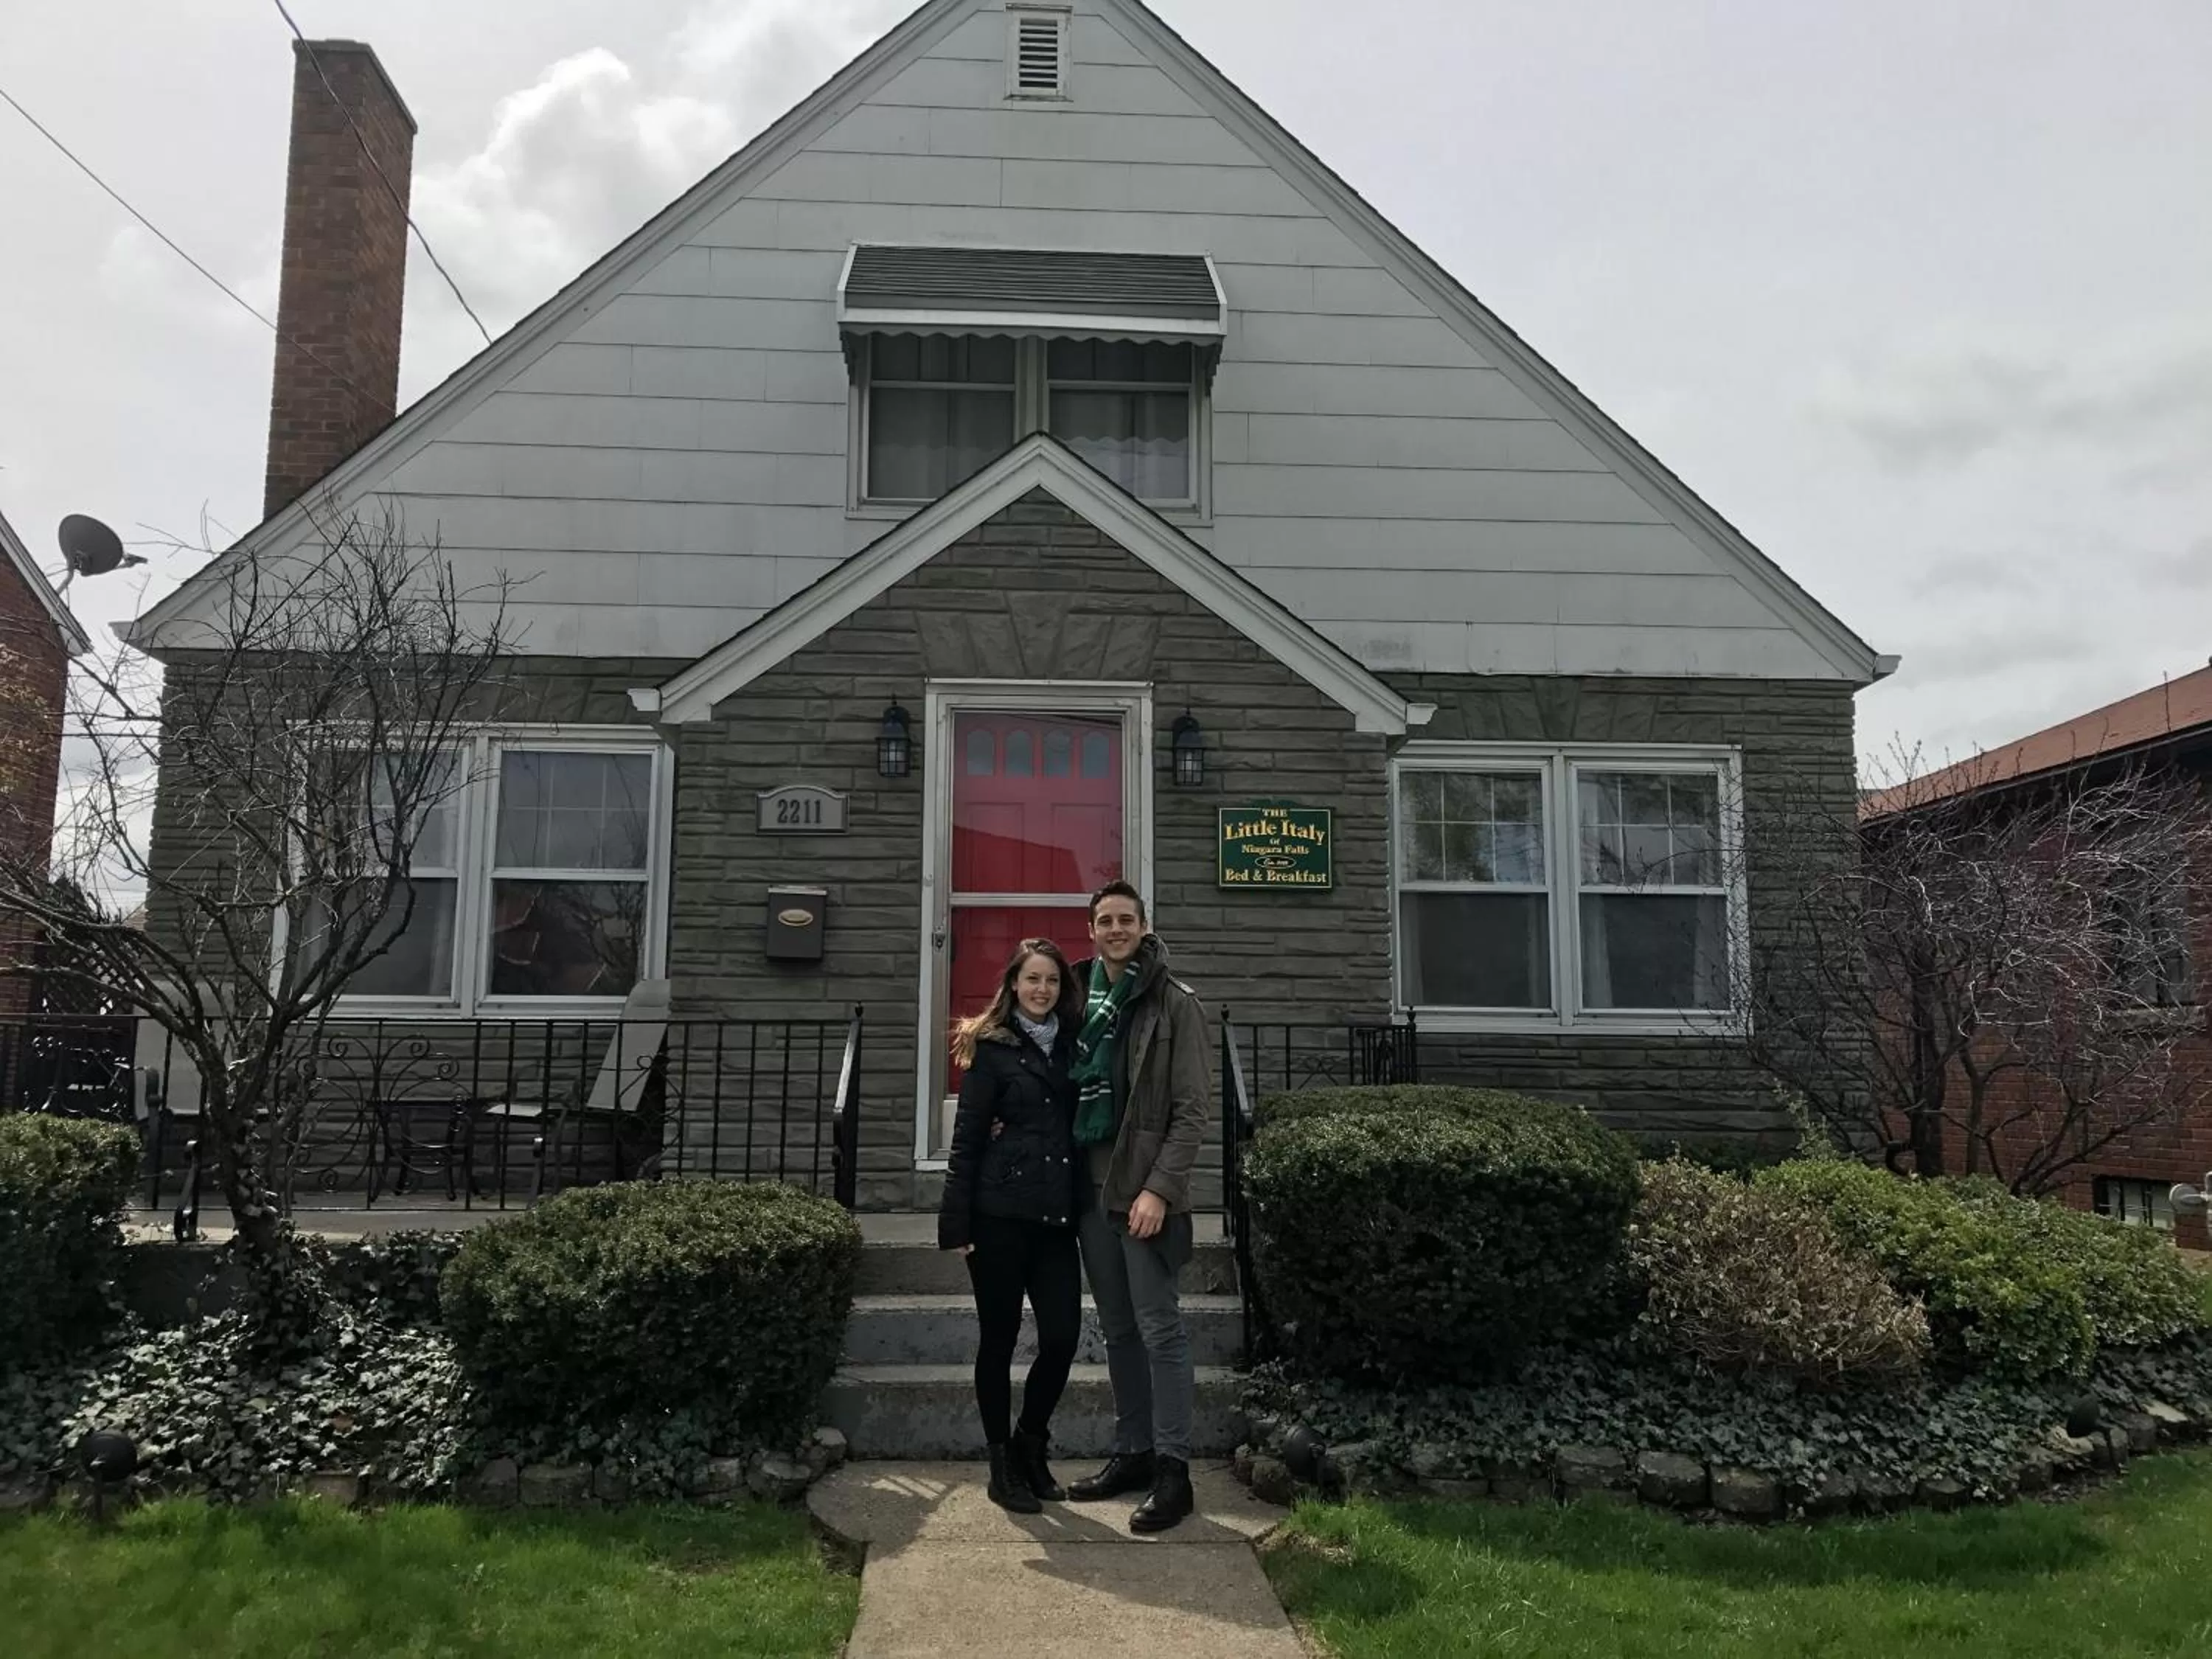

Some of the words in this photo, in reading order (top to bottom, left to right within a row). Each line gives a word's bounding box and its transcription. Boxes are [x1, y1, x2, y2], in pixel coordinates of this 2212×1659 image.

[777, 799, 822, 824] 2211
[1262, 808, 1287, 817] THE
[1225, 820, 1277, 840] Little
[1281, 820, 1325, 845] Italy
[1242, 845, 1282, 855] Niagara
[1284, 845, 1310, 855] Falls
[1225, 869, 1249, 881] Bed
[1253, 869, 1262, 881] &
[1267, 869, 1326, 883] Breakfast
